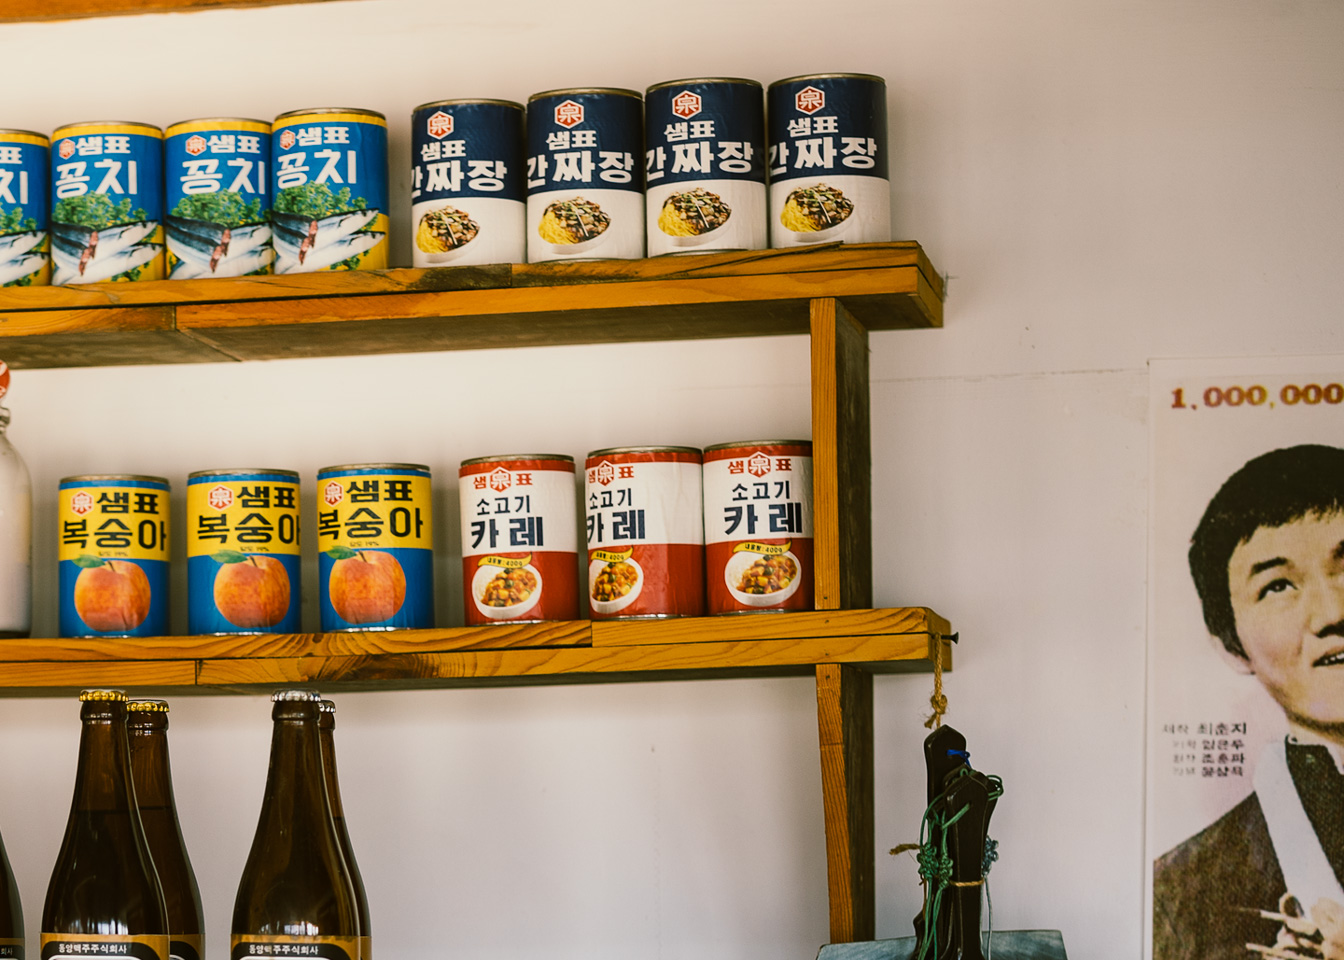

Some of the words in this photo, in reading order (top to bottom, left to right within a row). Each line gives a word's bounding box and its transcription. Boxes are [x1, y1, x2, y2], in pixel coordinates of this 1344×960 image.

[296, 126, 350, 147] 샘표
[664, 120, 715, 142] 샘표
[787, 116, 839, 137] 샘표
[76, 136, 131, 156] 샘표
[207, 134, 261, 154] 샘표
[421, 140, 466, 162] 샘표
[546, 130, 597, 151] 샘표
[55, 158, 138, 199] 꽁치
[180, 158, 265, 194] 꽁치
[276, 149, 356, 190] 꽁치
[237, 486, 296, 509] 샘표
[346, 480, 413, 503] 샘표
[589, 488, 632, 510] 소고기
[732, 480, 790, 501] 소고기
[96, 492, 159, 515] 샘표
[477, 495, 530, 516] 소고기
[197, 513, 301, 546] 복숭아
[319, 507, 423, 540] 복숭아
[587, 509, 646, 543] 카레
[724, 502, 803, 535] 카레
[63, 518, 166, 551] 복숭아
[471, 517, 544, 549] 카레
